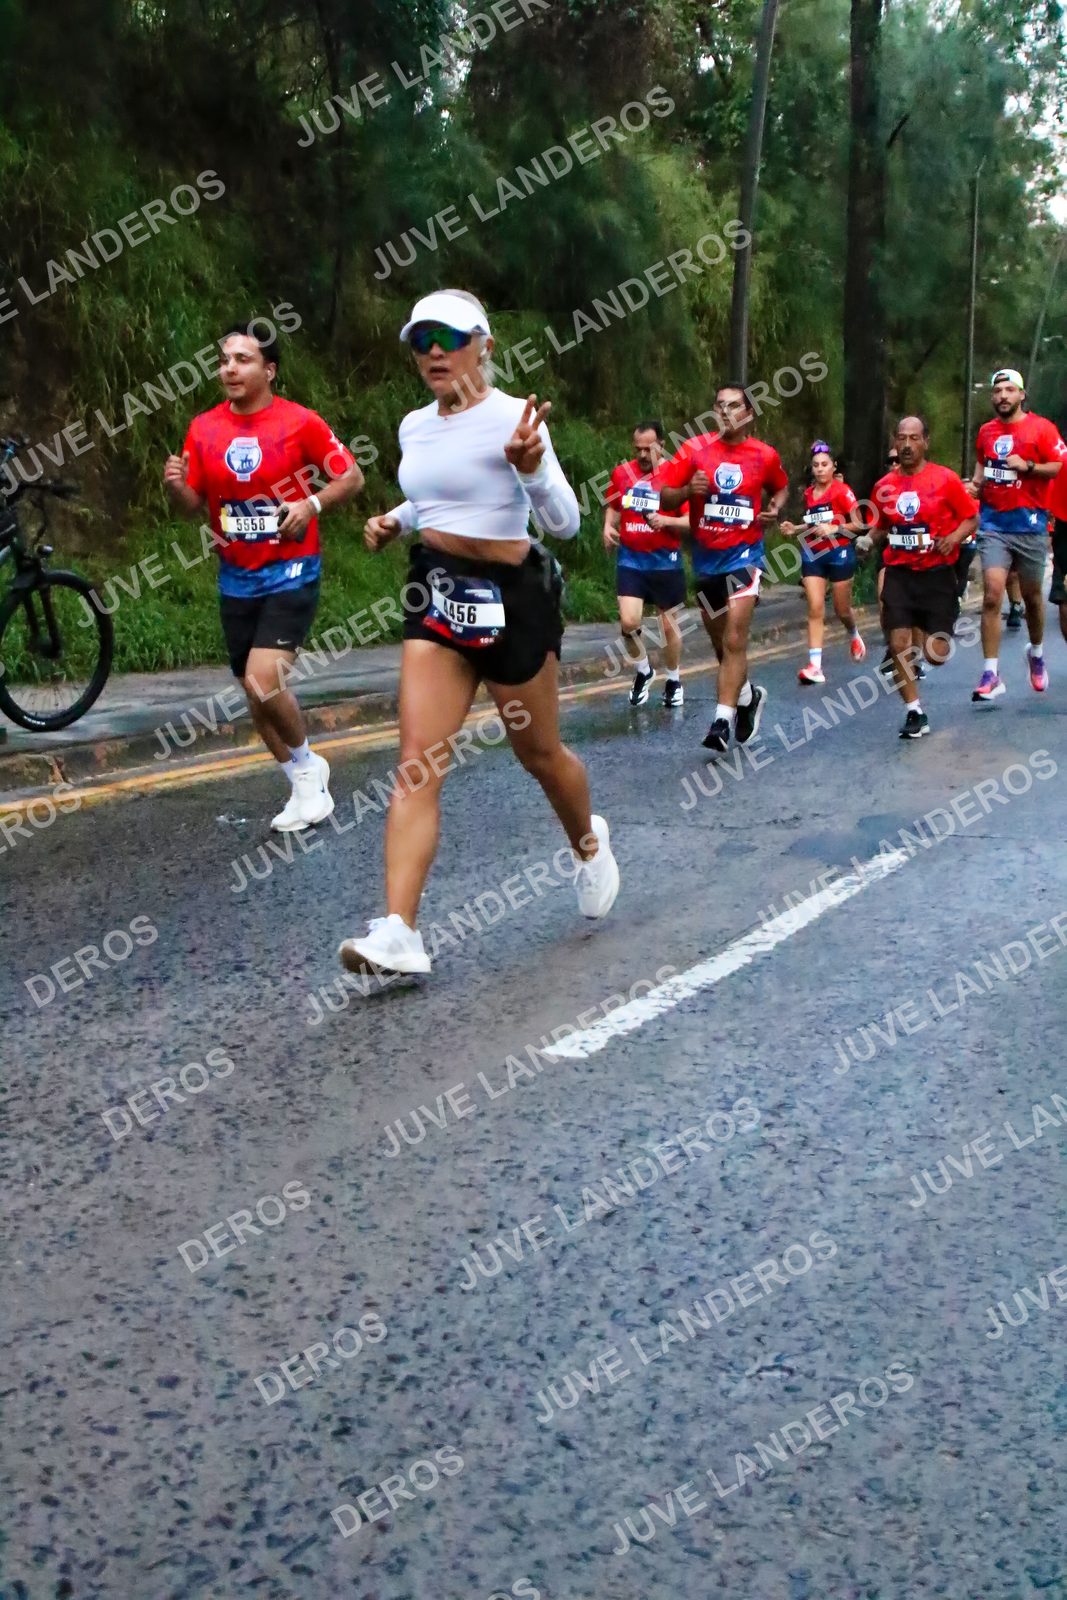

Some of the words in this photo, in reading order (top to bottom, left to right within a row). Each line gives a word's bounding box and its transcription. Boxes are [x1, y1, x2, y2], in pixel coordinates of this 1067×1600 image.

[719, 506, 740, 518] 4470
[236, 517, 266, 531] 5558
[444, 599, 477, 625] 4456
